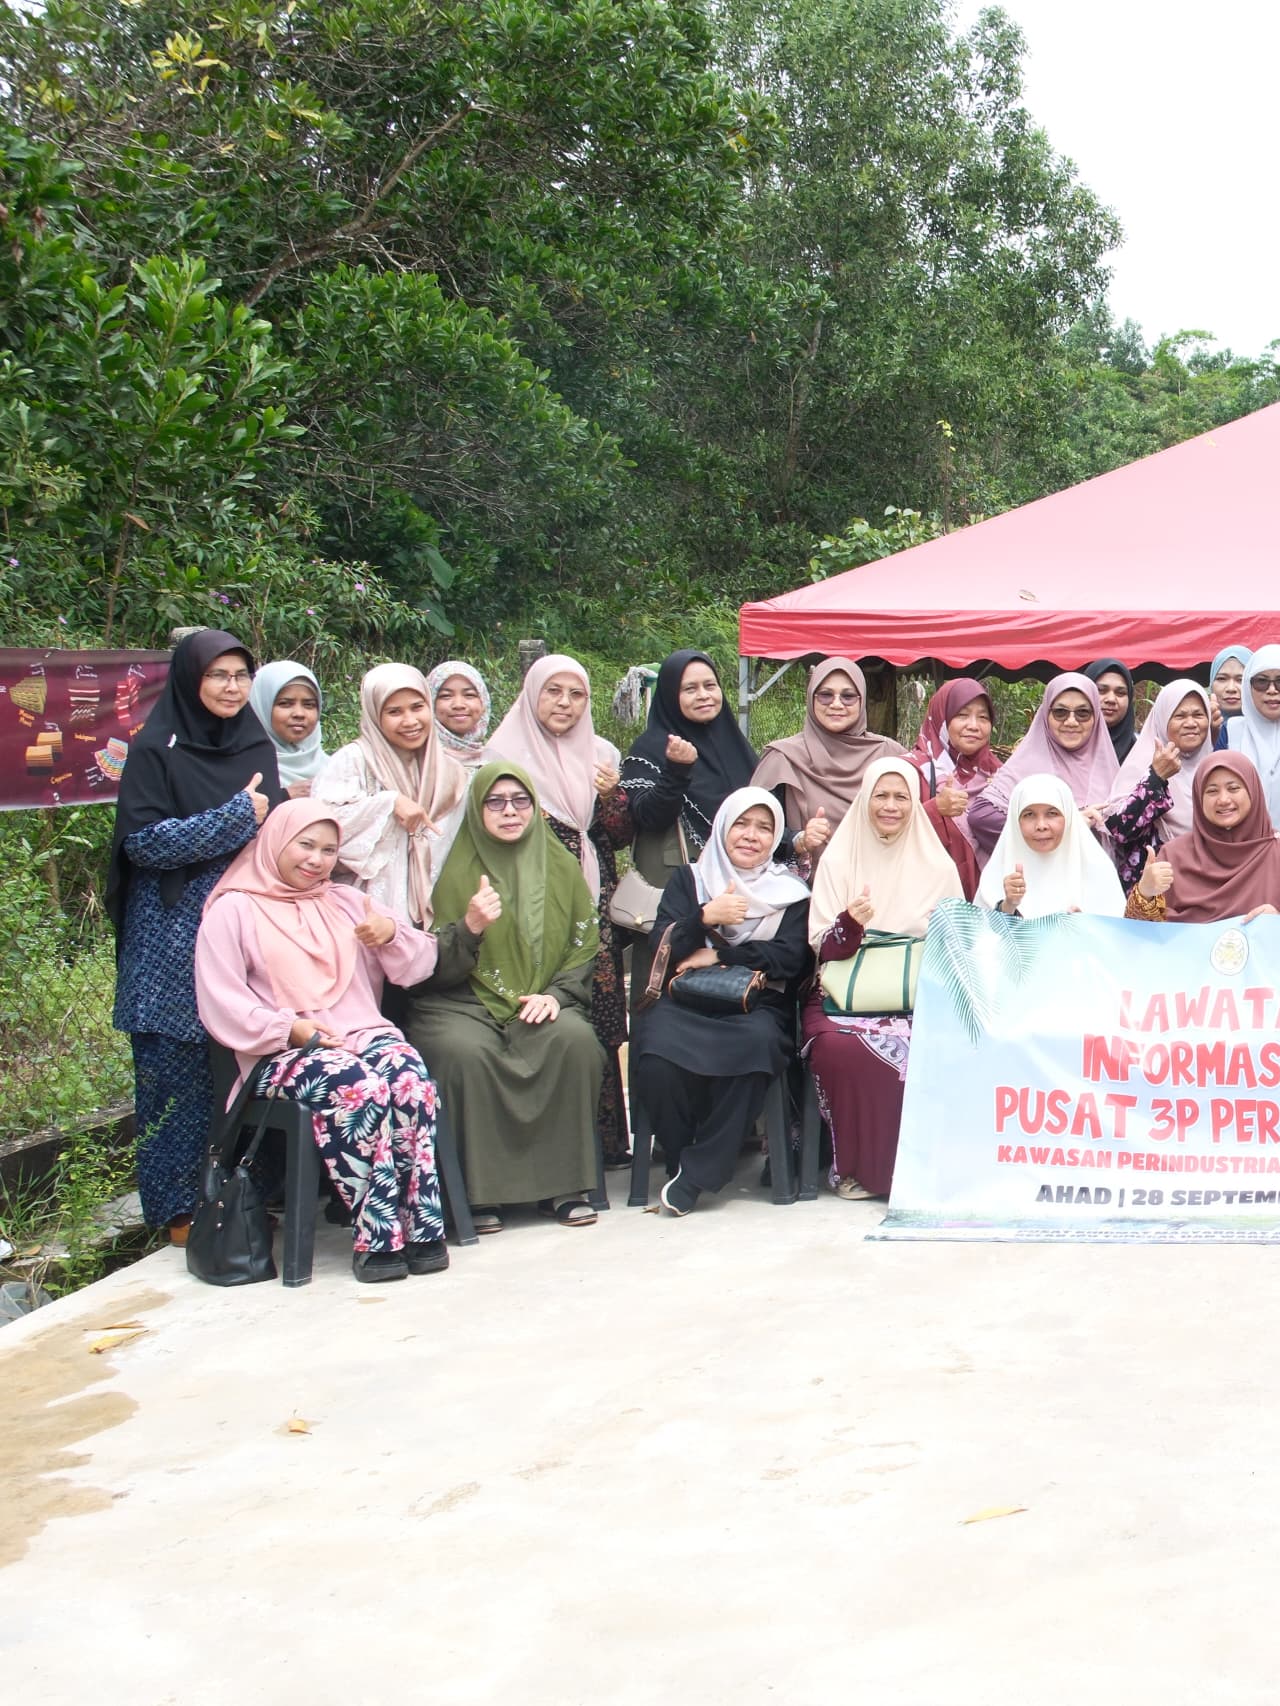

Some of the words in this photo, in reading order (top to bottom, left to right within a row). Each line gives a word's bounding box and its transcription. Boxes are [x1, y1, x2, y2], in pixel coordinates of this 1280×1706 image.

[995, 1085, 1138, 1139] PUSAT
[1149, 1098, 1200, 1143] 3P
[997, 1144, 1113, 1169] KAWASAN
[1035, 1184, 1113, 1205] AHAD
[1131, 1189, 1164, 1206] 28
